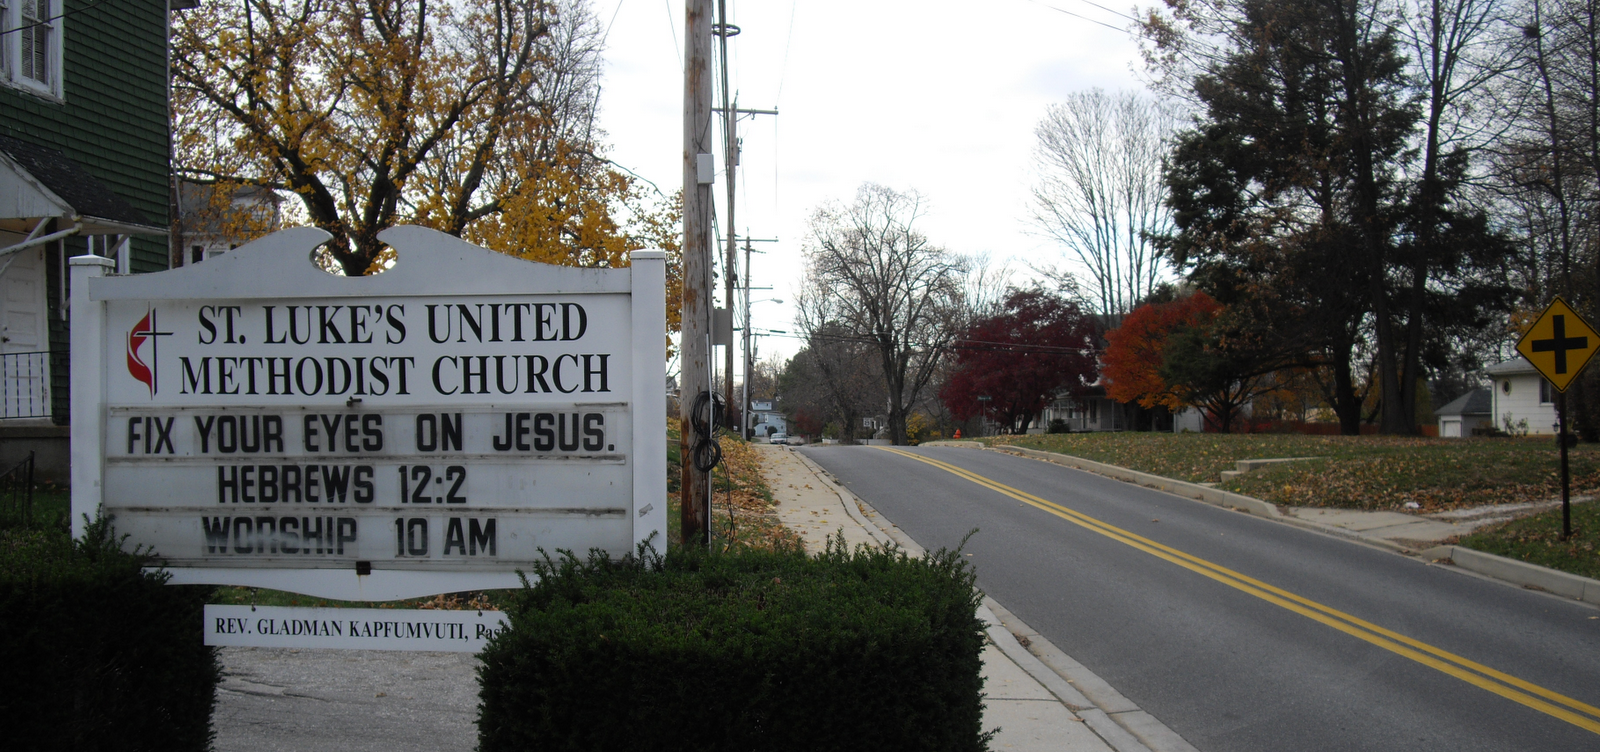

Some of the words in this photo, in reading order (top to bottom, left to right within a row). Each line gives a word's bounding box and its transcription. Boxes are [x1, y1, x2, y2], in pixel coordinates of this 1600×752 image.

[198, 305, 246, 345] ST.
[264, 304, 407, 345] LUKE'S
[427, 302, 588, 343] UNITED
[179, 356, 415, 396] METHODIST
[431, 354, 611, 394] CHURCH
[127, 416, 175, 455] FIX
[194, 415, 284, 454] YOUR
[304, 414, 383, 453] EYES
[415, 413, 463, 452] ON
[492, 412, 615, 452] JESUS.
[217, 465, 375, 504] HEBREWS
[398, 465, 467, 504] 12:2
[202, 516, 357, 555] WORSHIP
[395, 517, 428, 557] 10
[443, 517, 497, 557] AM
[215, 617, 252, 635] REV.
[257, 618, 343, 638] GLADMAN
[348, 620, 469, 643] KAPFUMVUTI,
